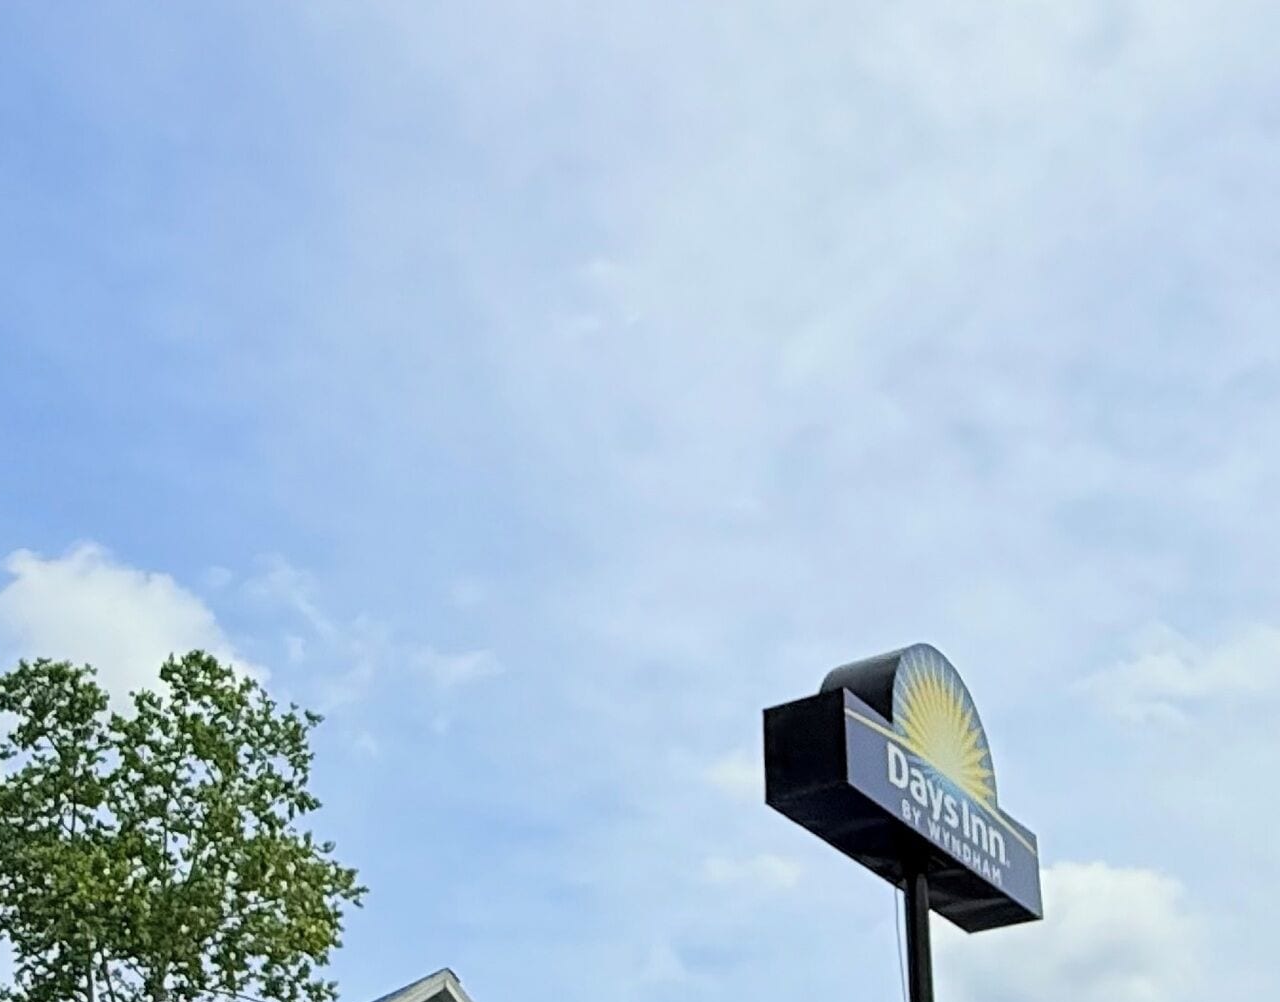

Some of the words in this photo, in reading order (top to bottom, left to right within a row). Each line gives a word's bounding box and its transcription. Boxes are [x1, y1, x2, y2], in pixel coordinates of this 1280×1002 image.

[887, 742, 960, 829] Days
[961, 799, 1006, 867] Inn
[901, 798, 921, 827] BY
[927, 816, 1002, 887] WYNDHAM
